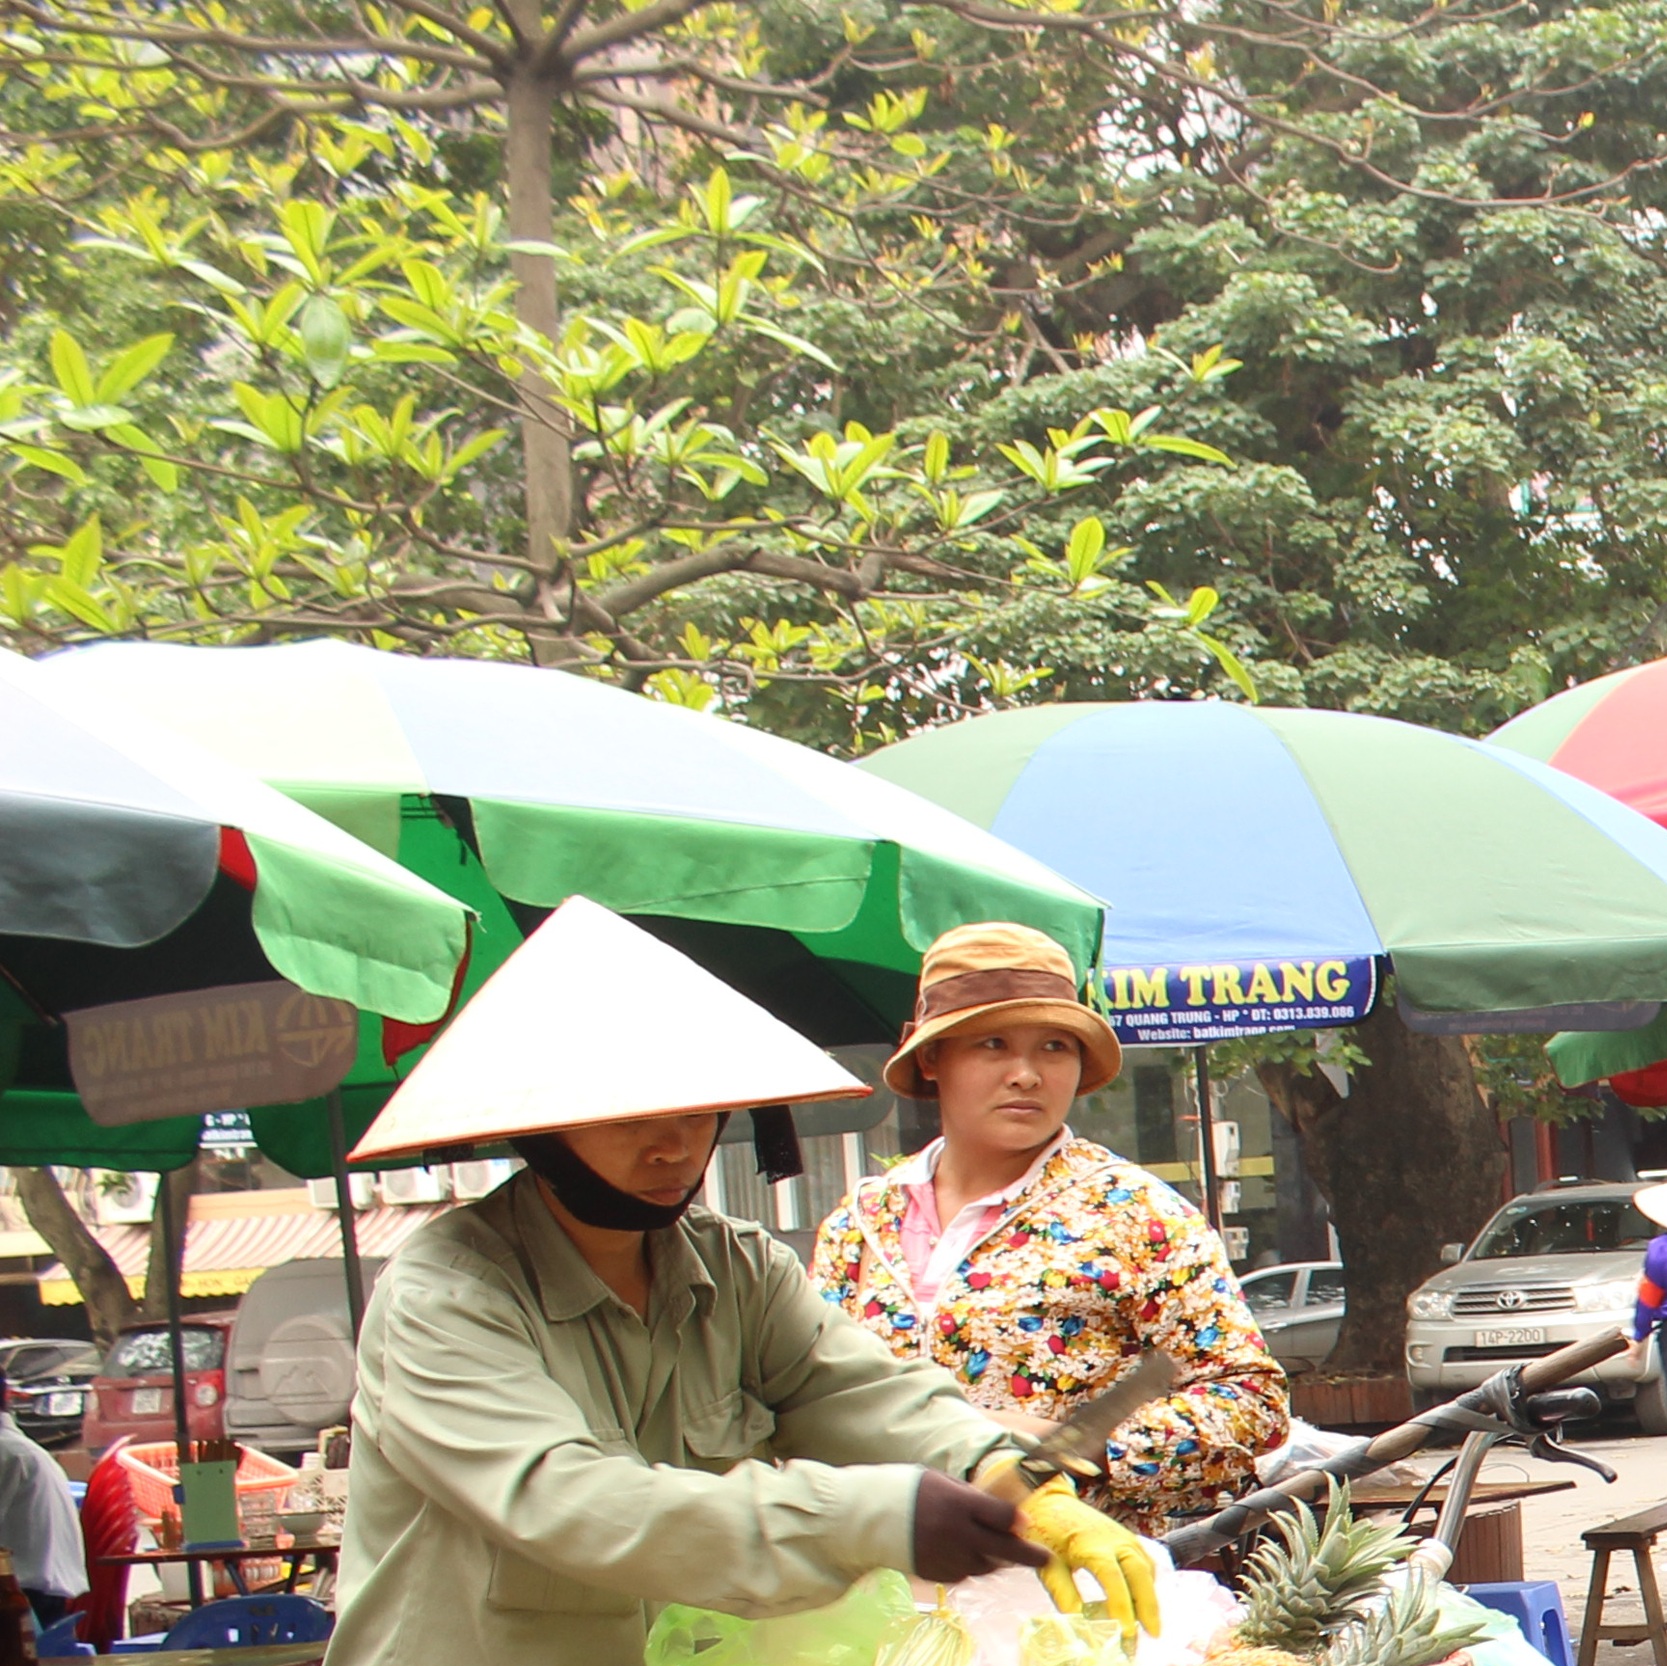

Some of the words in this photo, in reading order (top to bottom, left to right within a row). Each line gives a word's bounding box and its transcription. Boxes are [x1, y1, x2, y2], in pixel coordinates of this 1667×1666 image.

[1180, 960, 1350, 1006] TRANG
[1126, 1011, 1168, 1027] QUANG
[1171, 1009, 1211, 1025] TRUNG
[1222, 1008, 1240, 1022] HP
[1273, 1005, 1354, 1021] 0313.839.086
[1137, 1028, 1191, 1042] Website:
[1481, 1328, 1541, 1345] 14P-2200
